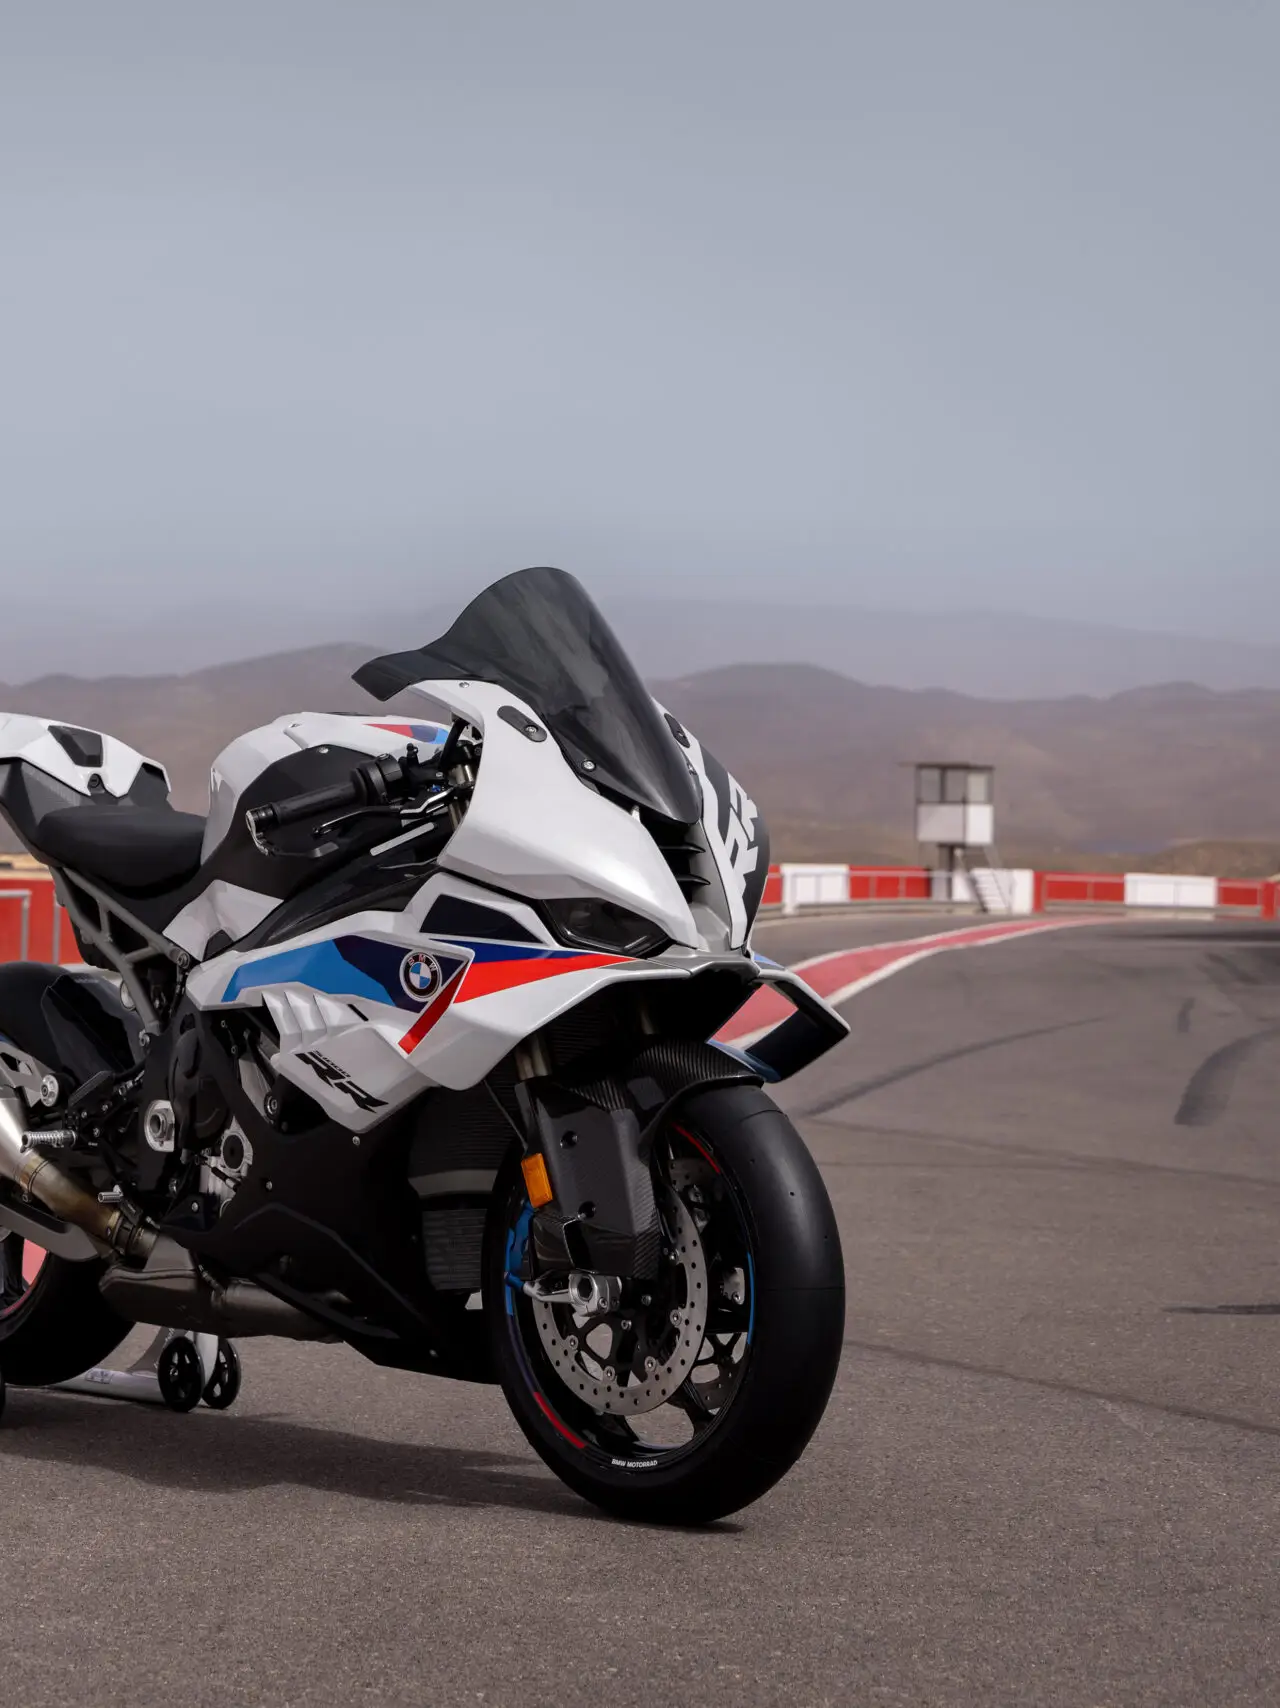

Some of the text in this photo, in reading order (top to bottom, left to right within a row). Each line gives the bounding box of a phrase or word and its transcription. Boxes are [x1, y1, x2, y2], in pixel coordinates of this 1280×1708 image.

[408, 953, 438, 971] BMW
[295, 1052, 389, 1114] RR
[611, 1459, 626, 1467] BMW
